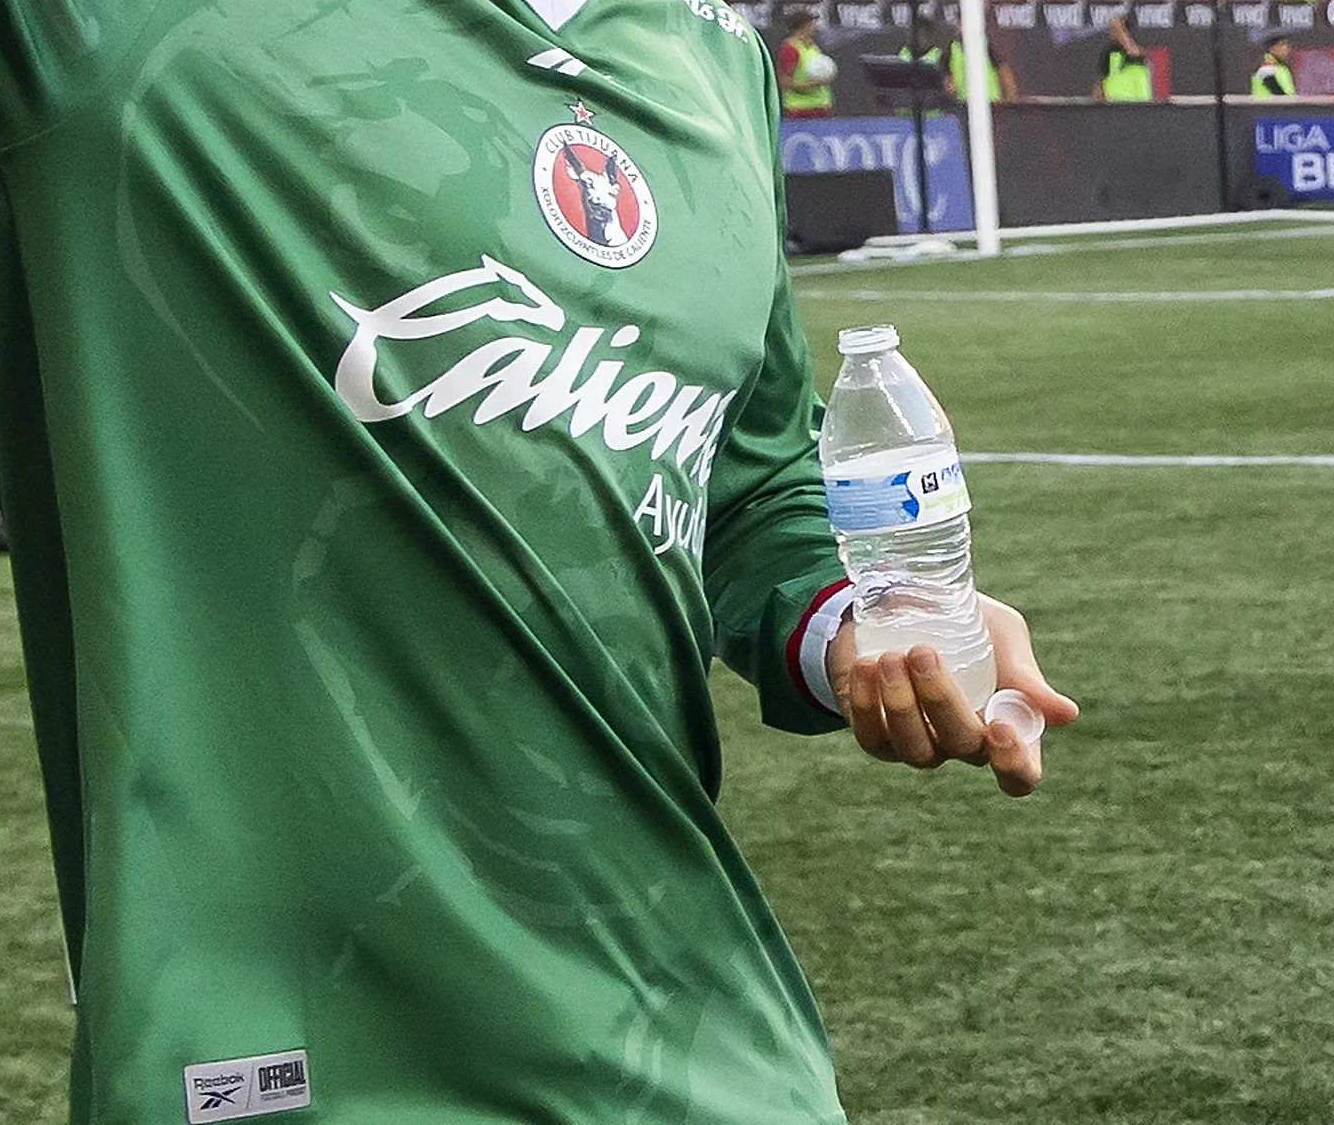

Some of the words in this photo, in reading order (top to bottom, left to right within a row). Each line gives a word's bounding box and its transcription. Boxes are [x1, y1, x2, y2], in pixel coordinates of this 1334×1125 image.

[1255, 123, 1331, 153] LIGA
[545, 129, 574, 154] CLUB
[576, 130, 638, 184] TIJUANA
[613, 248, 627, 261] DE
[193, 1071, 245, 1089] Reebok
[258, 1059, 307, 1092] OFFICIAL
